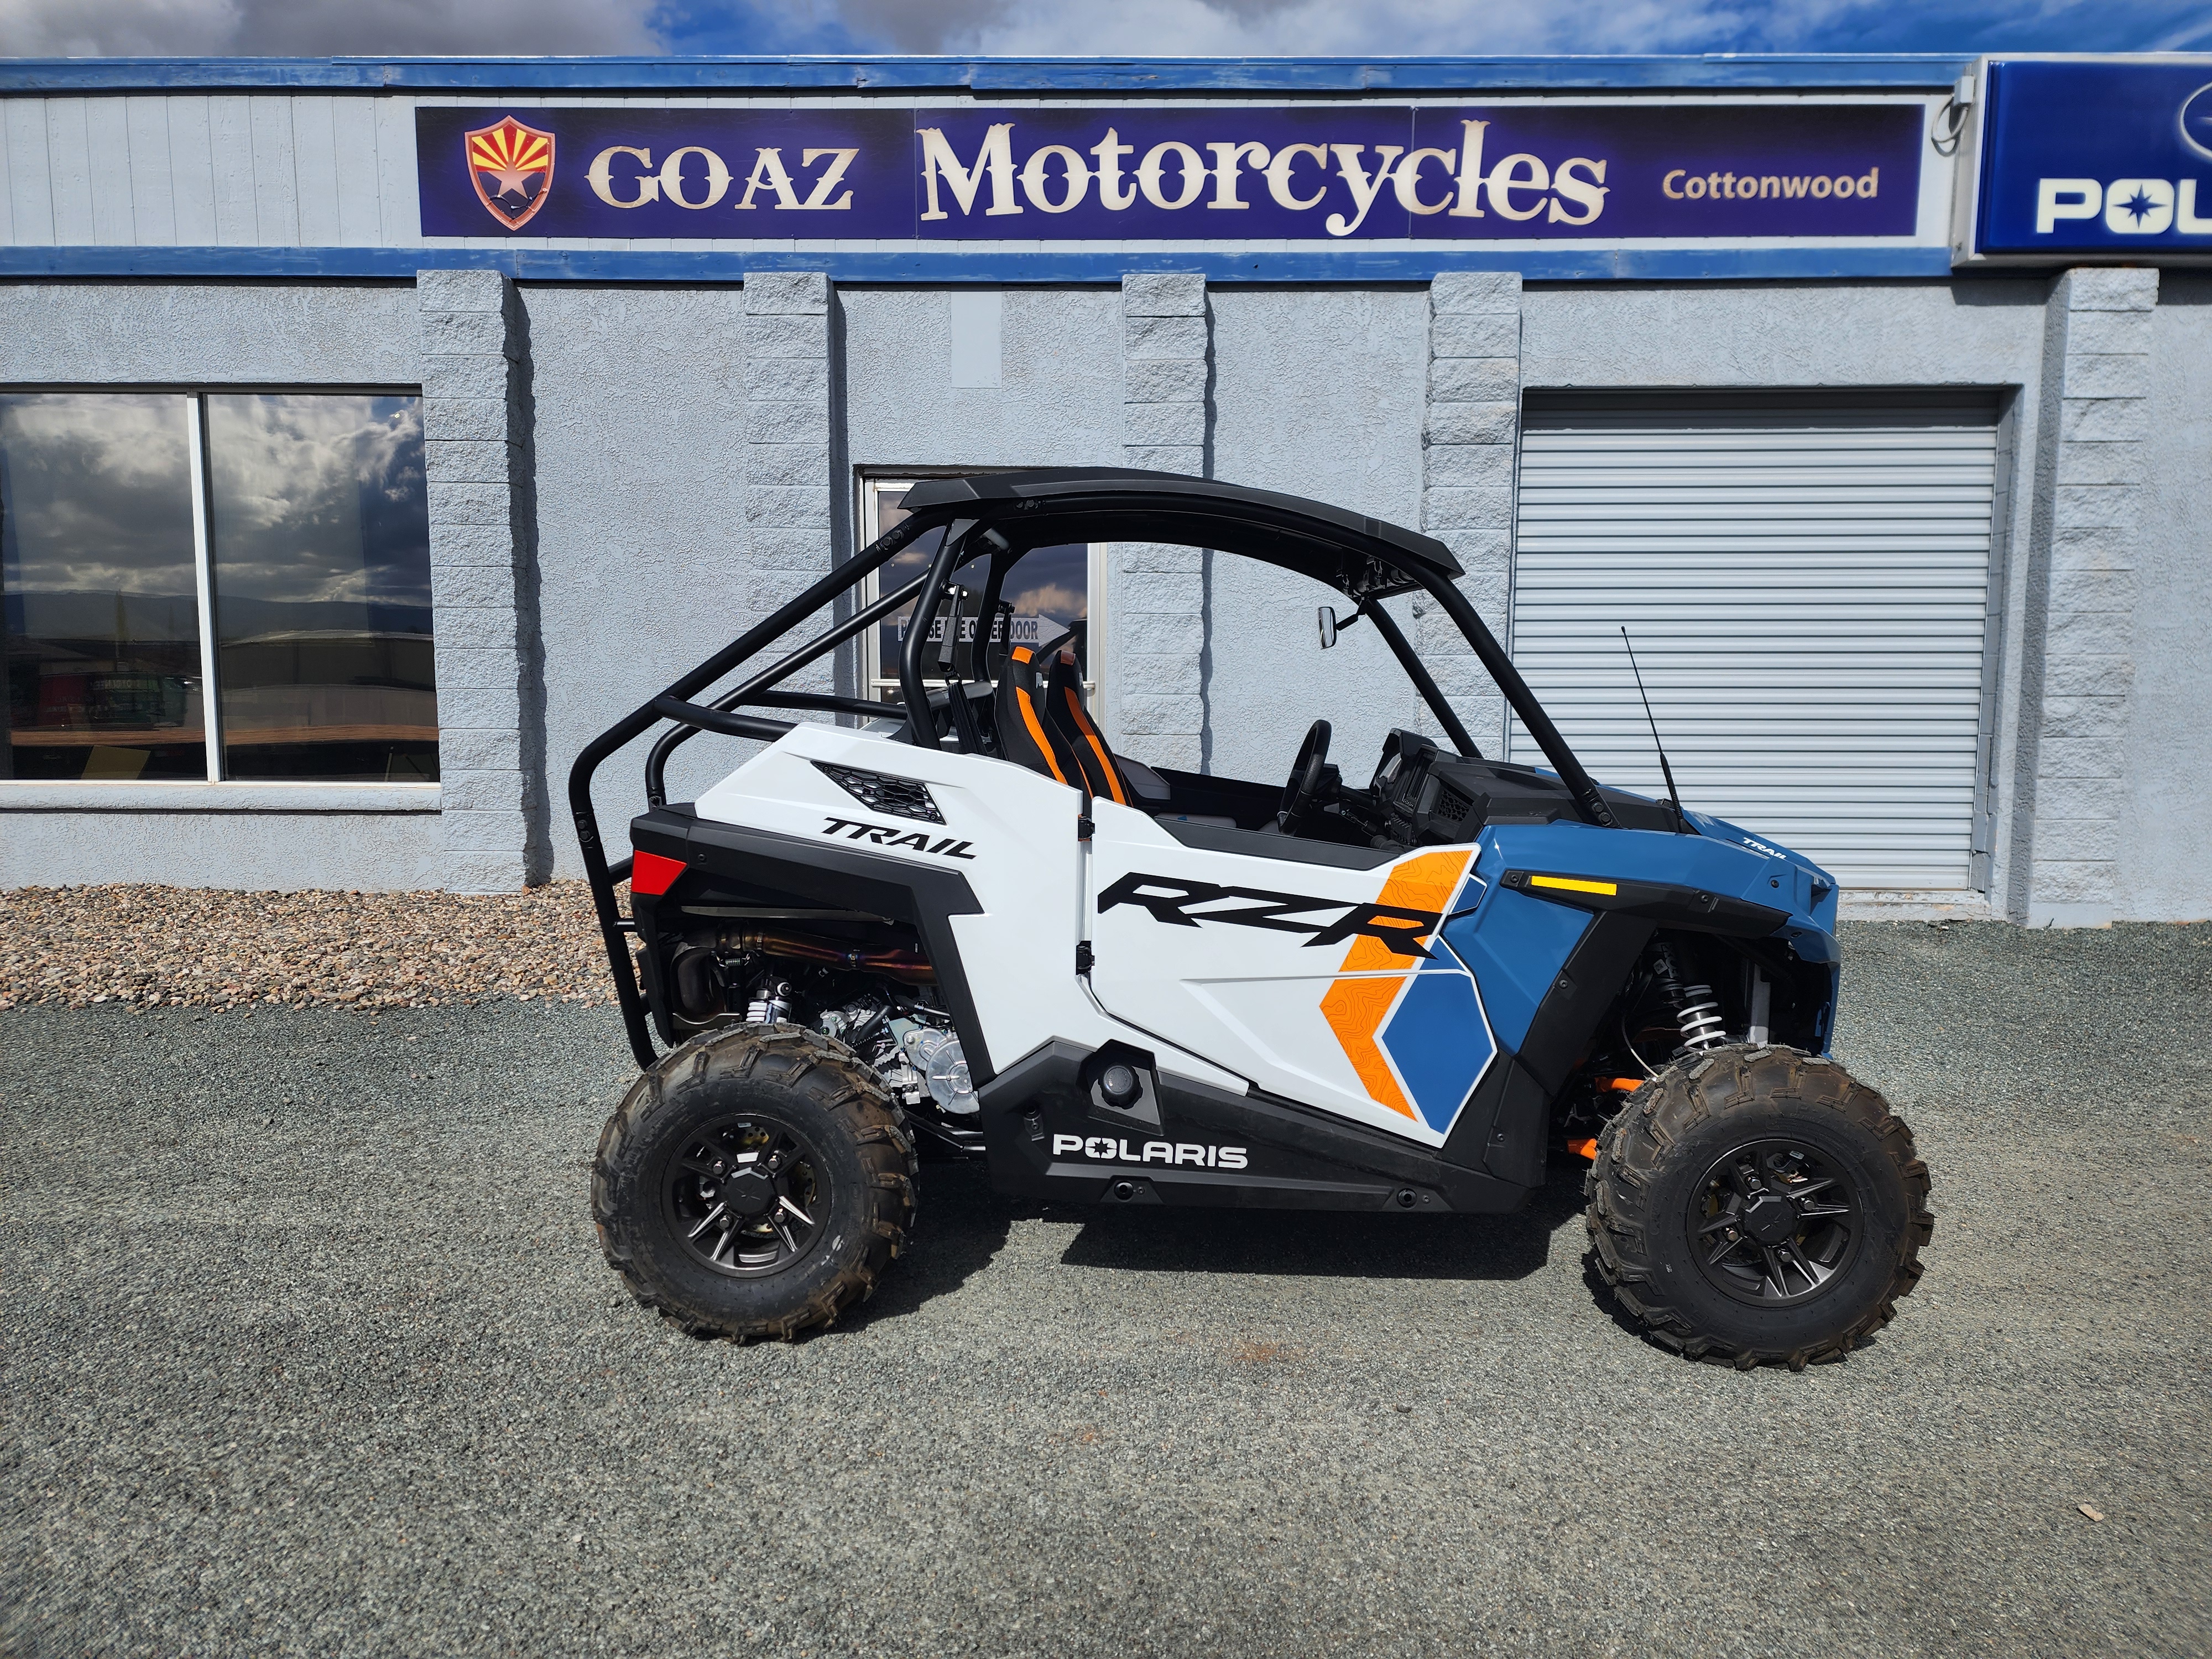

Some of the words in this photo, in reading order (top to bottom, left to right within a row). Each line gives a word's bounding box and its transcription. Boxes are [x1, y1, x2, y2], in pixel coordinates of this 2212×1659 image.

[916, 119, 1611, 237] Motorcycles
[1662, 166, 1879, 199] Cottonwood
[822, 817, 977, 860] TRAIL
[1743, 837, 1787, 859] TRAIL
[1097, 872, 1443, 960] RZR
[1053, 1134, 1248, 1169] POLARIS
